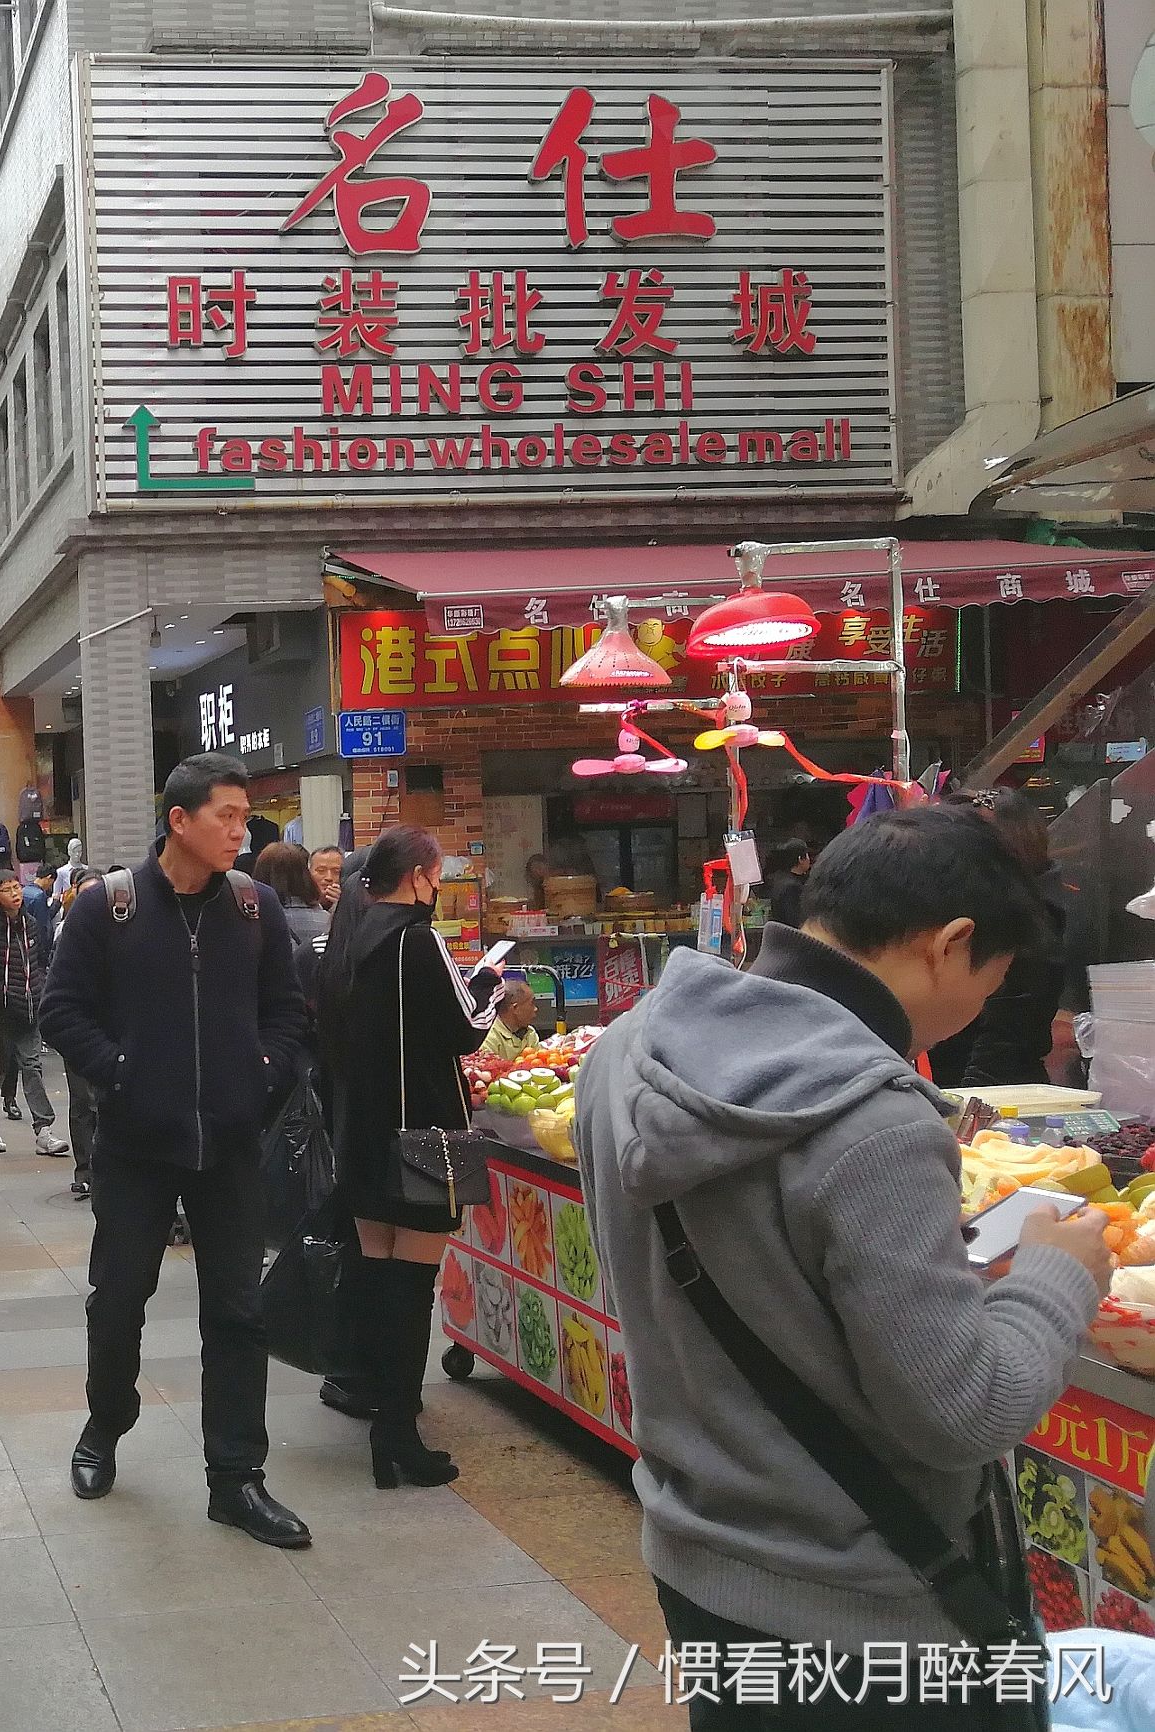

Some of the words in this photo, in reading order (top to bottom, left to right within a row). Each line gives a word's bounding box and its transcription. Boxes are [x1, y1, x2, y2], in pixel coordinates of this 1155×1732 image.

[279, 71, 718, 256] 名仕
[166, 267, 817, 358] 时装批发城
[321, 361, 524, 416] MING
[565, 360, 694, 415] SHI
[193, 425, 416, 473] fashion
[428, 421, 727, 468] wholesale
[738, 418, 852, 464] mall
[840, 568, 1096, 608] 名仕商城
[199, 684, 235, 751] 职柜
[361, 731, 382, 746] 91
[1034, 1404, 1148, 1487] 元1斤
